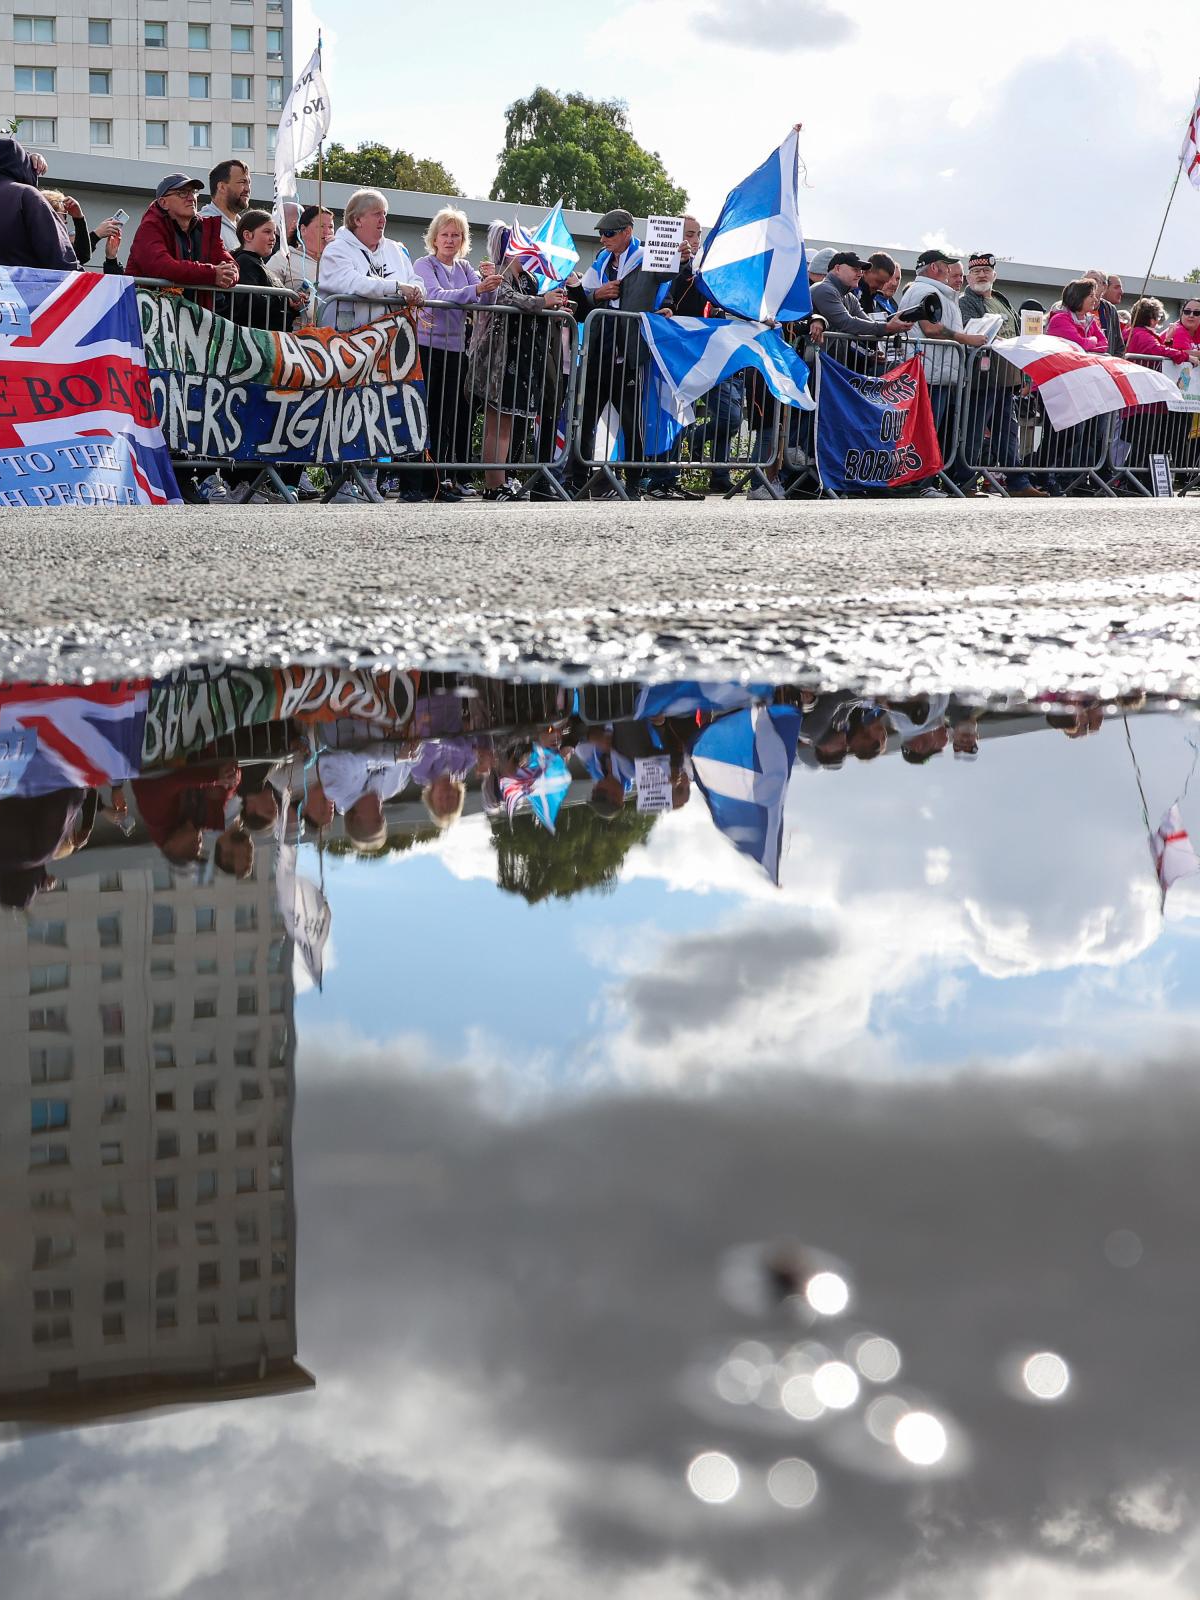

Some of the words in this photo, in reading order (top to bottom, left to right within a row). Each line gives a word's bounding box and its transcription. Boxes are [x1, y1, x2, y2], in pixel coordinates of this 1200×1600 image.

[278, 315, 416, 388] ADORED
[257, 383, 428, 463] IGNORED
[0, 451, 56, 477] TO
[58, 444, 123, 471] THE
[30, 481, 137, 506] PEOPLE
